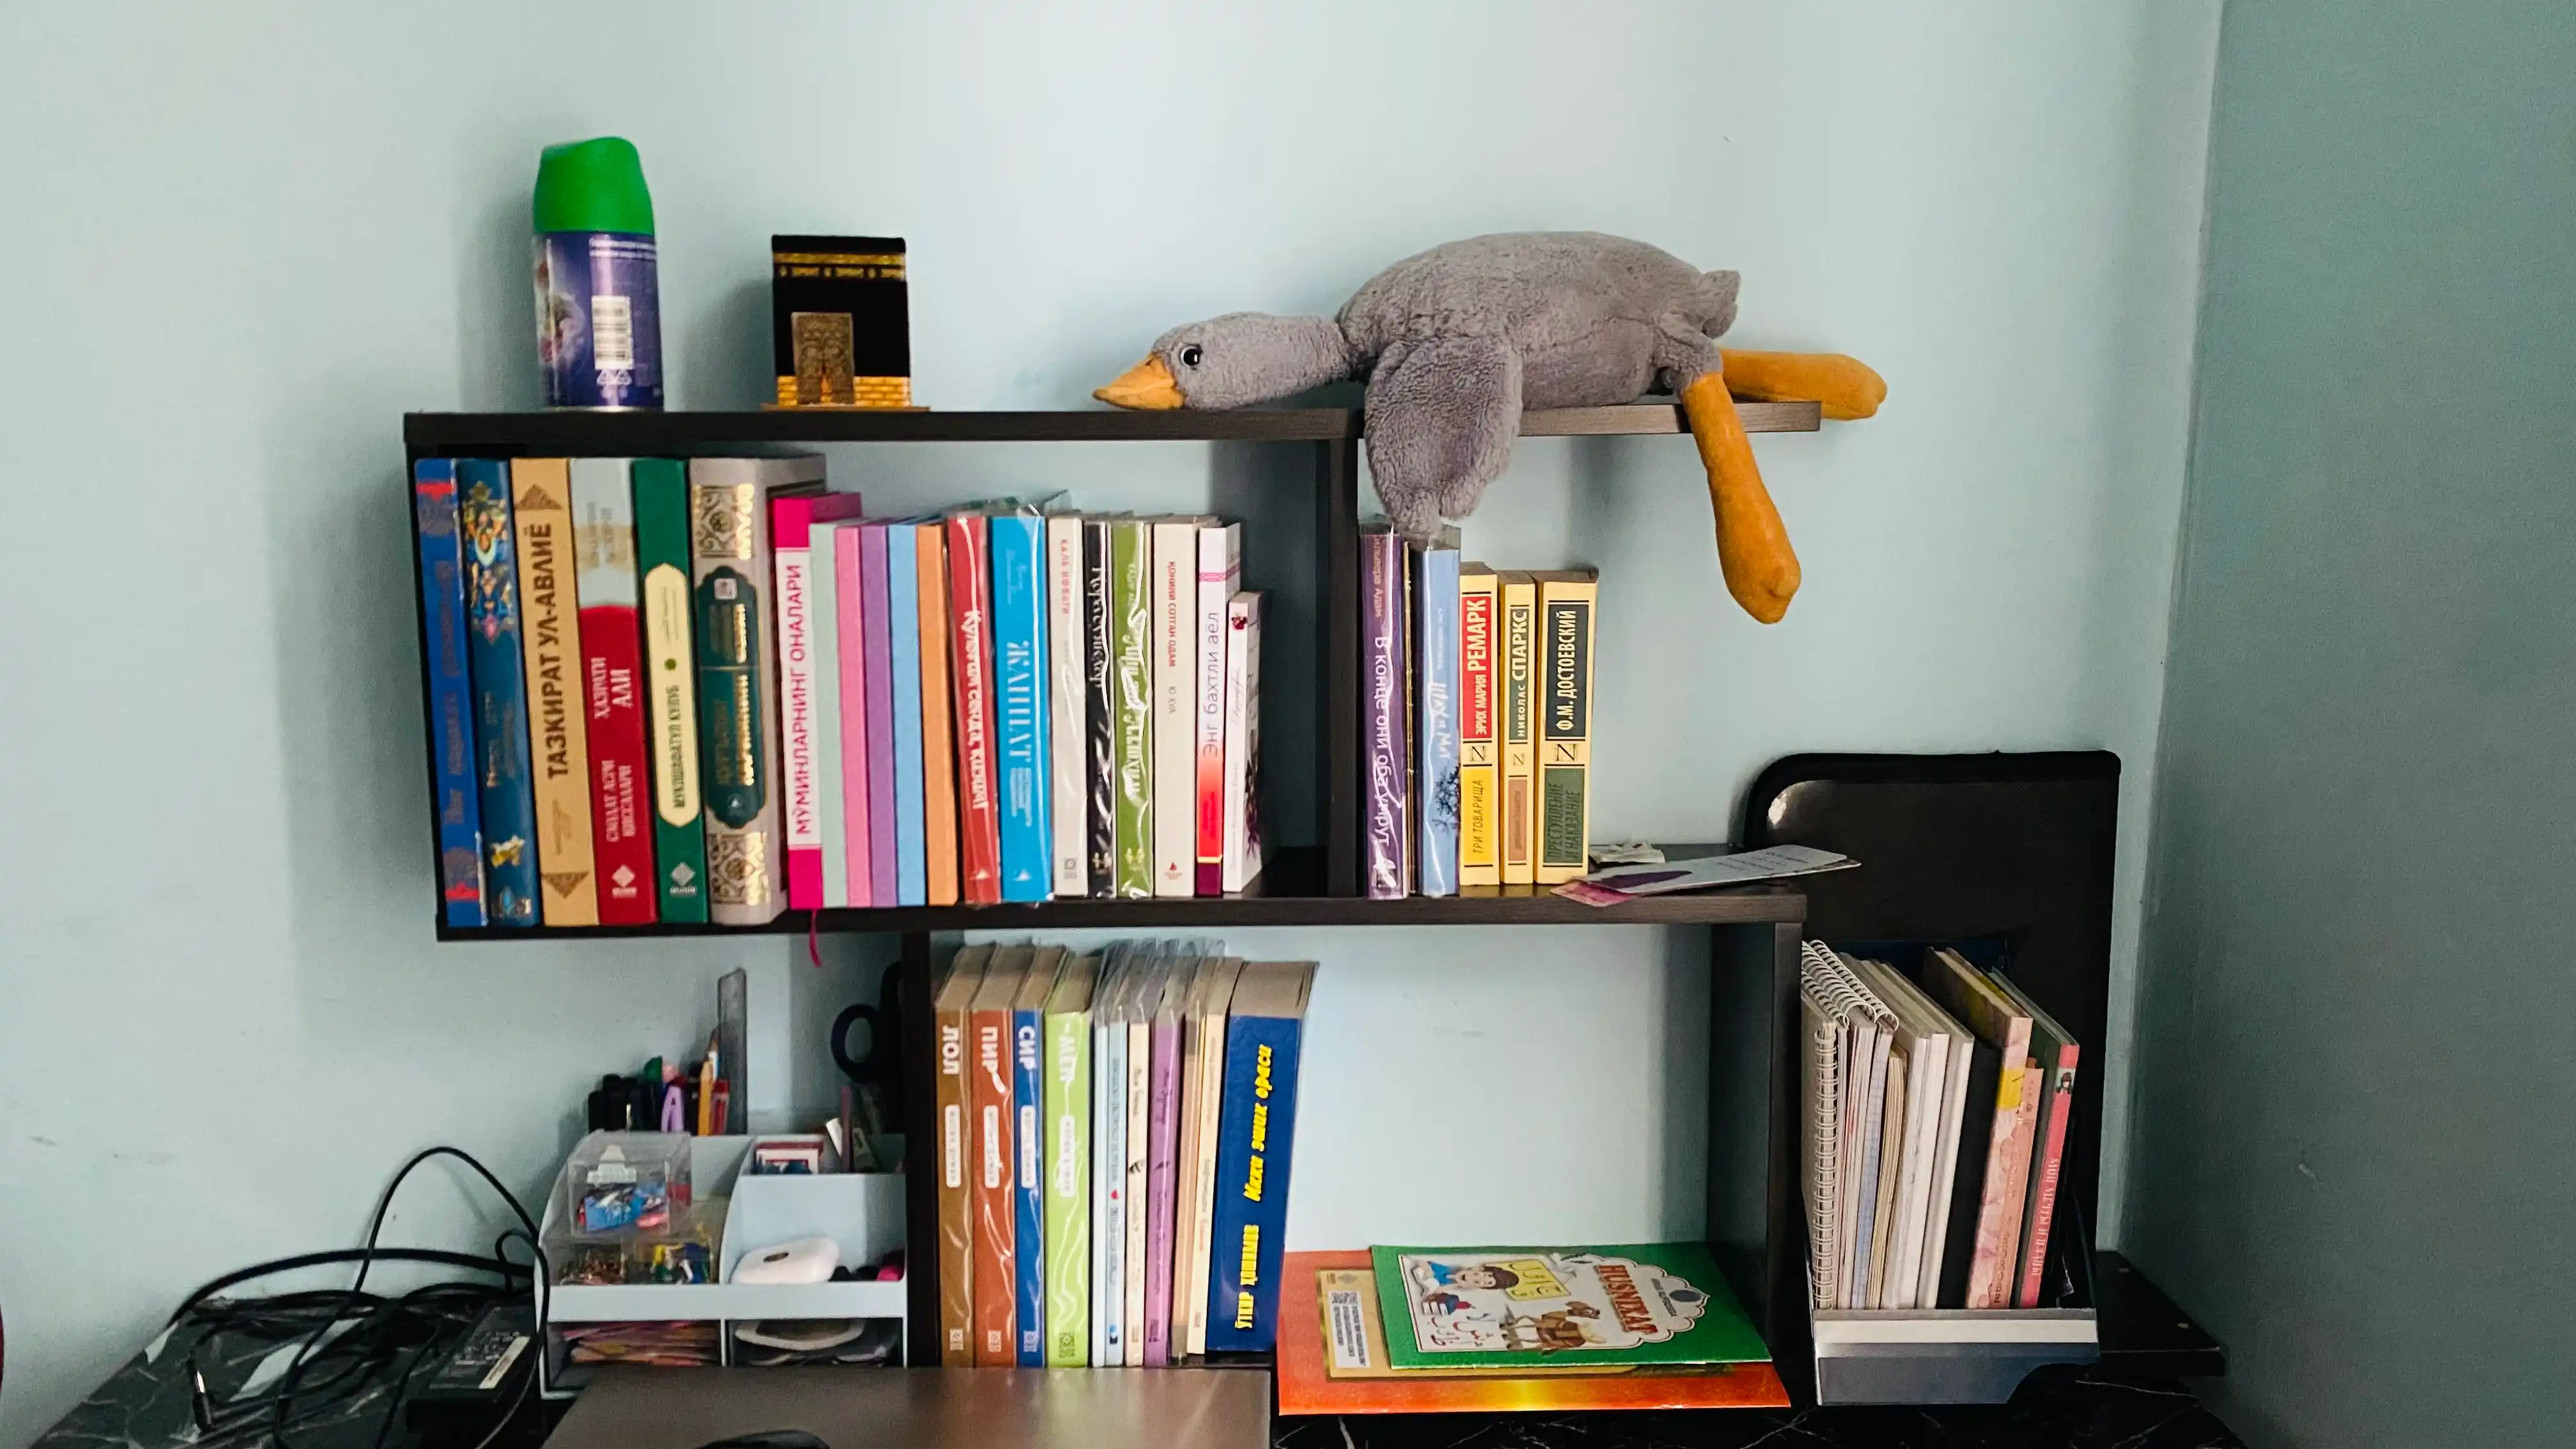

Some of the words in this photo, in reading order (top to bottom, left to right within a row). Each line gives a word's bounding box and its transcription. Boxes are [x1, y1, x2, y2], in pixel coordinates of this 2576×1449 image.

[524, 523, 559, 647] УЛ-АВЛИЁ
[1372, 536, 1383, 585] ильвера
[786, 564, 805, 662] ОНАЛАРИ
[1168, 602, 1177, 637] СОТГАН
[1205, 611, 1220, 645] аёл
[1467, 599, 1487, 671] РЕМАРК
[1167, 639, 1177, 668] ОДАМ
[1374, 636, 1390, 649] В
[1511, 610, 1528, 681] СПАРКС
[1556, 610, 1577, 698] ДОСТОЕВСКИЙ
[610, 668, 634, 708] АЛИ
[1203, 651, 1219, 715] бахтли
[1372, 654, 1391, 709] конце
[1475, 674, 1487, 709] МАРИЯ
[540, 654, 568, 779] ТАЗКИРАТ
[1375, 715, 1389, 749] они
[1475, 710, 1488, 735] ЭРИХ
[1516, 684, 1526, 737] НИКОЛАС
[1558, 701, 1575, 730] Ф.М.
[1202, 723, 1218, 758] Энг
[1375, 755, 1393, 788] оба
[1472, 779, 1484, 833] ТОВАРИЩА
[1547, 783, 1564, 857] ПРЕСТУПЛЕНИЕ
[1564, 790, 1581, 849] НАКАЗАНИЕ
[1473, 836, 1483, 854] ТРИ
[942, 1025, 960, 1075] ЛОЛ
[981, 1025, 999, 1073] ПИР
[1018, 1025, 1036, 1070] СИР
[1256, 1045, 1273, 1100] ораси
[1252, 1103, 1268, 1153] эшик
[1244, 1155, 1264, 1202] Икки
[1234, 1292, 1254, 1330] ЎТКИР
[1594, 1263, 1660, 1335] HUSNIXAT
